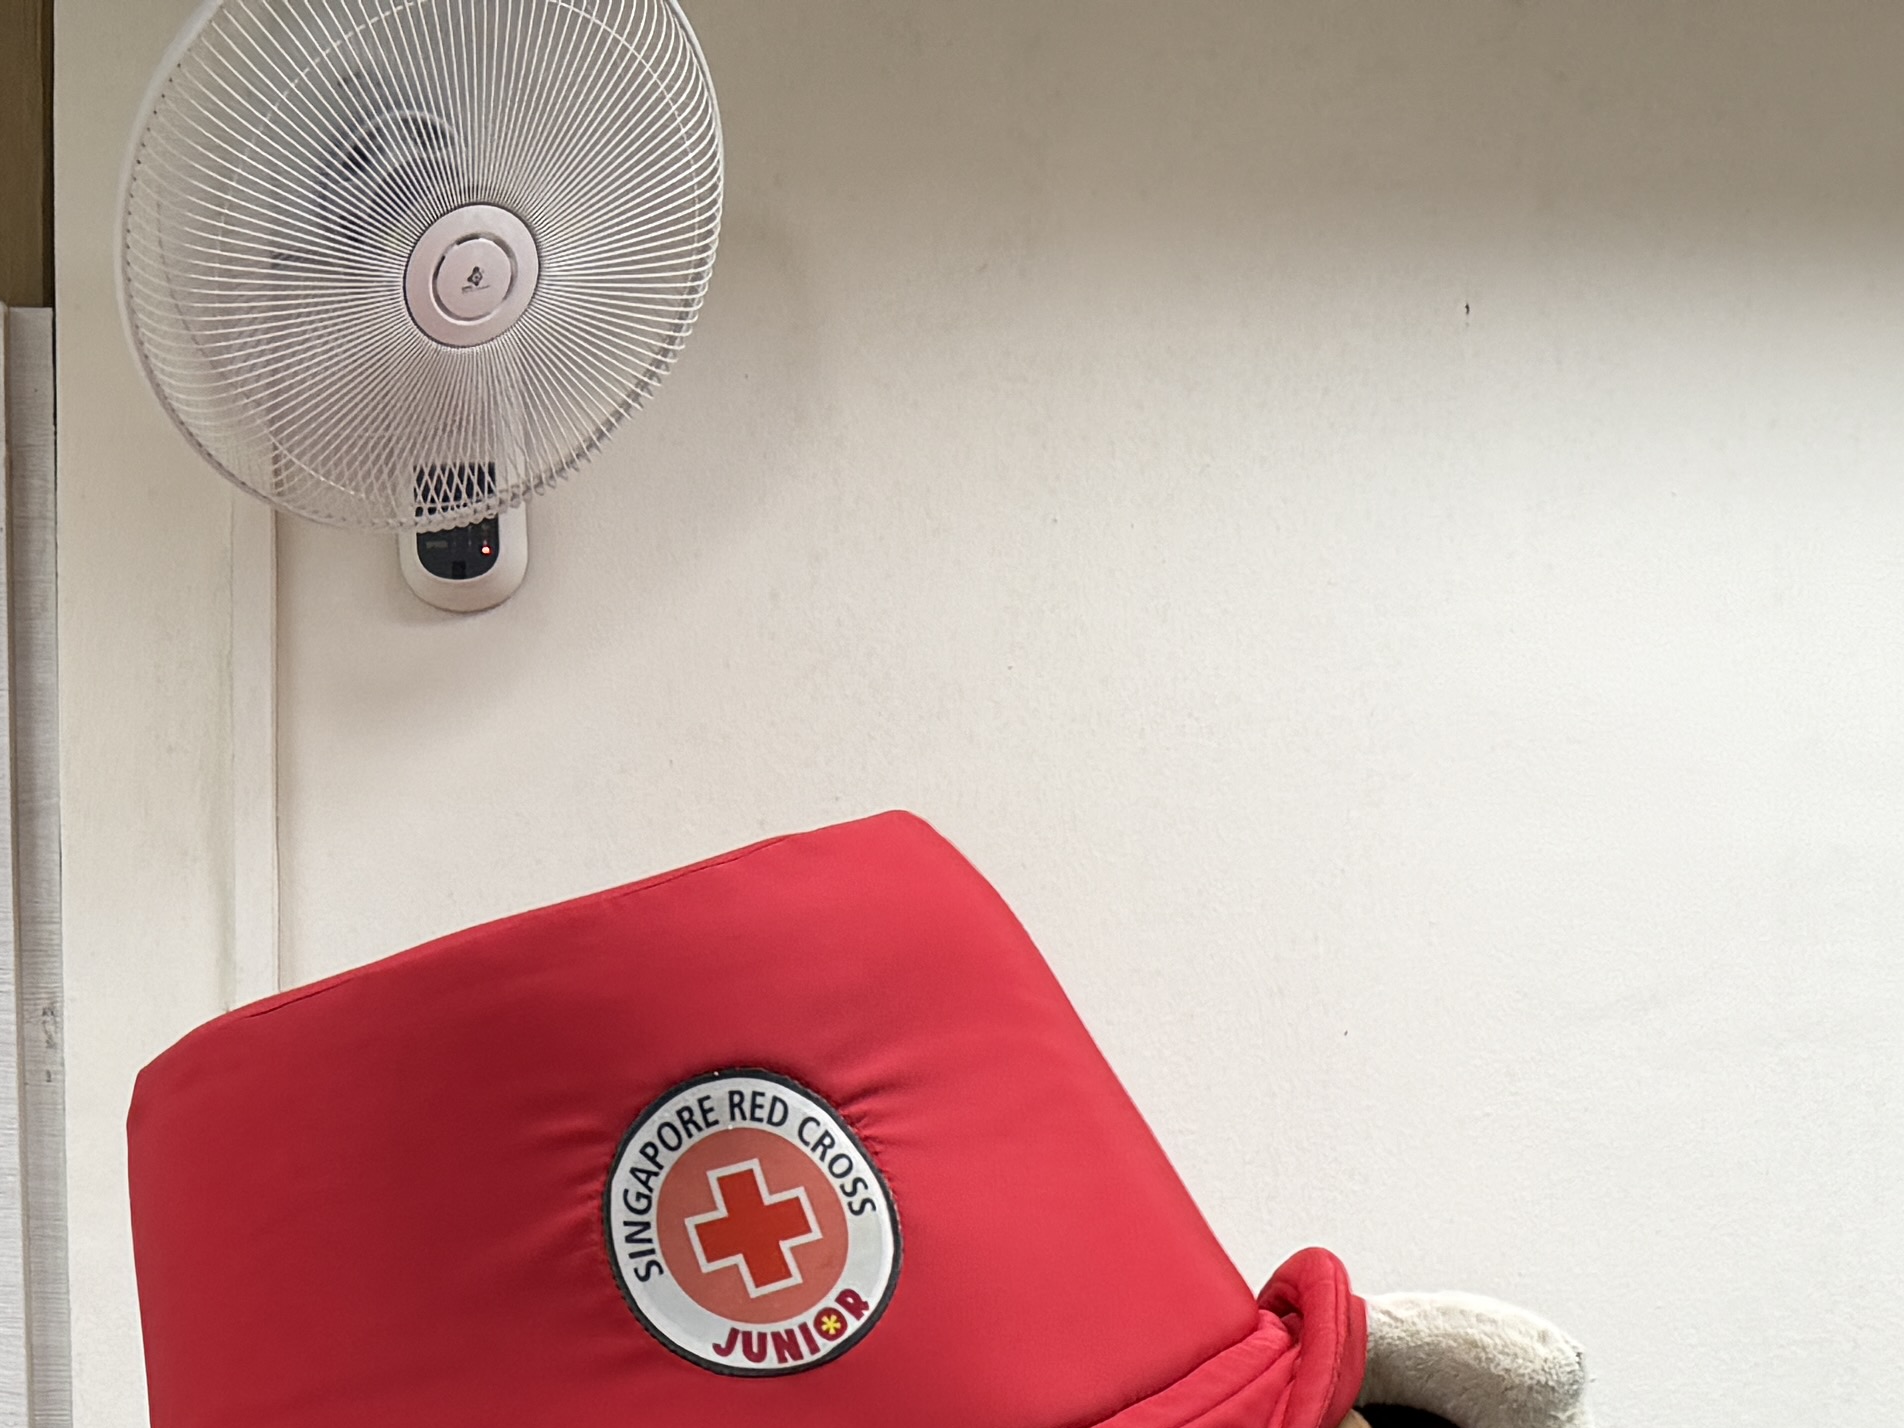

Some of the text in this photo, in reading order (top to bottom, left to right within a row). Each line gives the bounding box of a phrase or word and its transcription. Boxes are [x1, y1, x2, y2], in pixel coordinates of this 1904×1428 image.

[622, 1090, 877, 1283] SINGAPORE RED CROSS
[712, 1288, 870, 1364] JUNIOR
